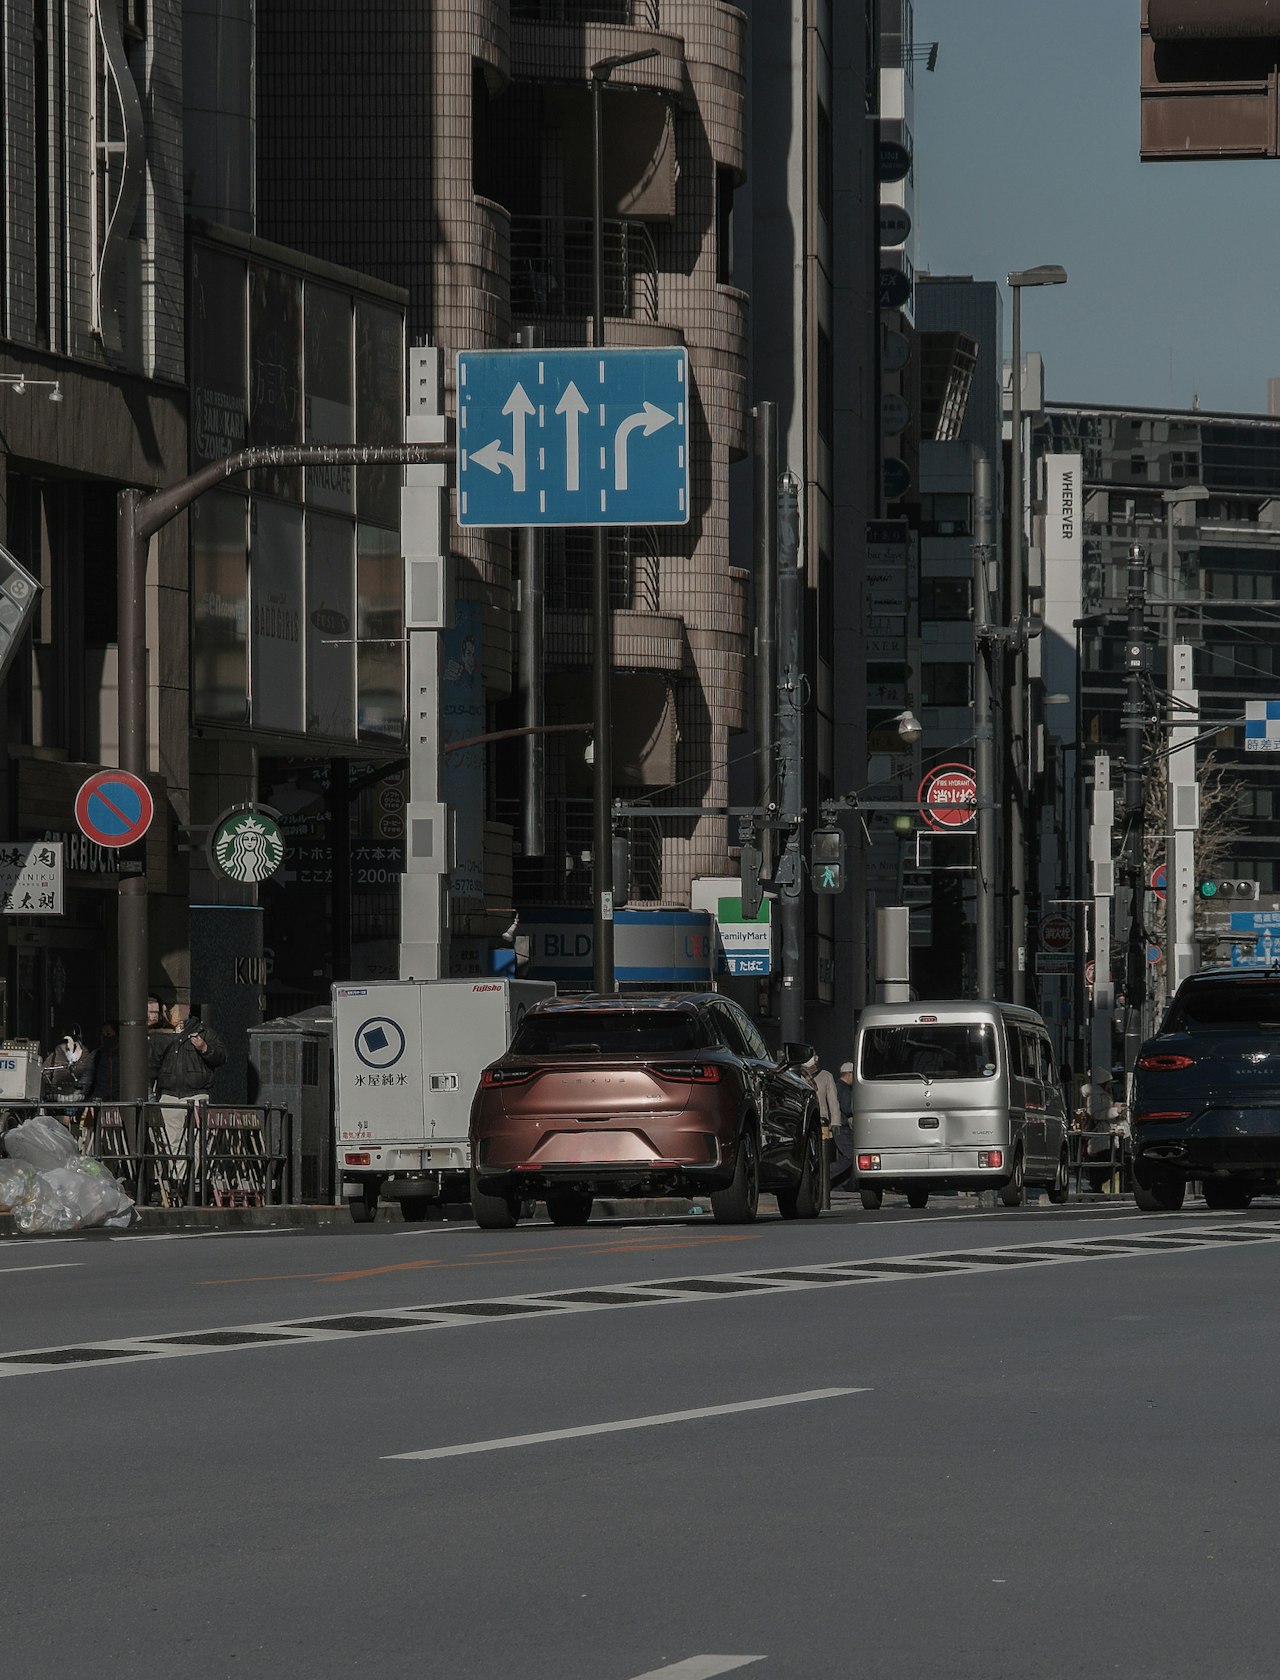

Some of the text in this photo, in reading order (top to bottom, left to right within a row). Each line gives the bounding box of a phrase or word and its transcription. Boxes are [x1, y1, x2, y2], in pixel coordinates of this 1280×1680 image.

[1062, 471, 1073, 539] WHEREVER
[719, 932, 767, 942] FamilyMart
[545, 942, 591, 957] BLD
[739, 960, 763, 971] たばこ
[472, 985, 503, 995] Fujisho
